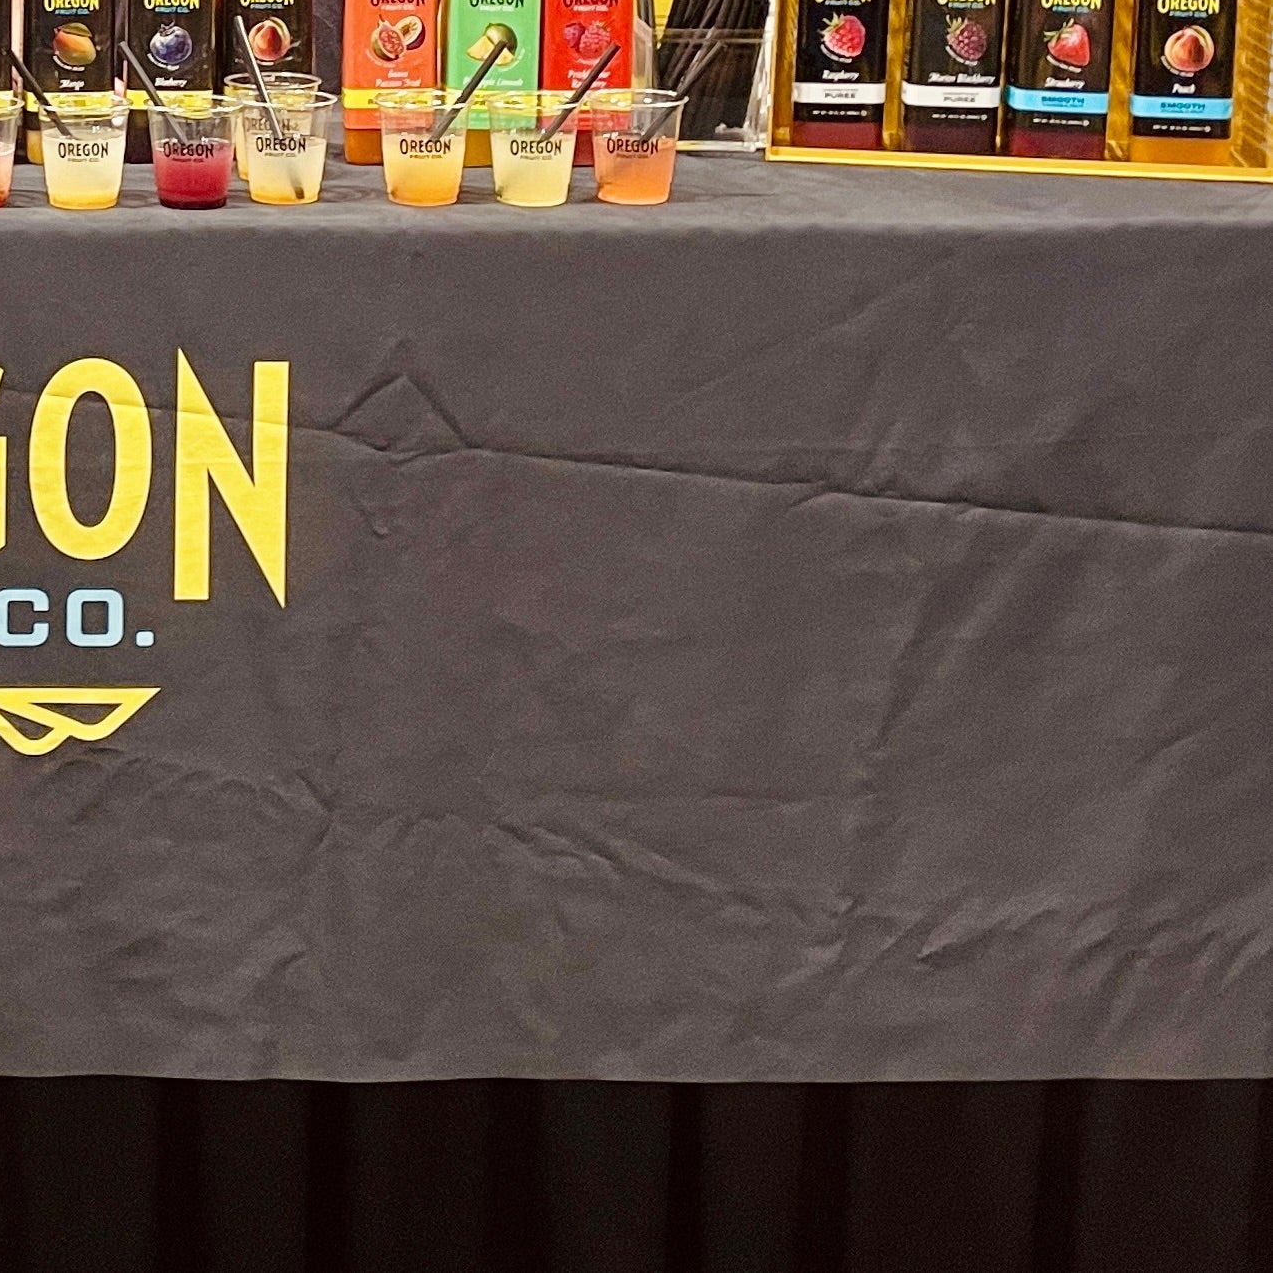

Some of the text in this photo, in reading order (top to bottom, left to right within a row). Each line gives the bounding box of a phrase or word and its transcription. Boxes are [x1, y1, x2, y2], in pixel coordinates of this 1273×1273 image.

[58, 142, 109, 159] OREGON
[163, 141, 214, 158] OREGON
[256, 136, 306, 153] OREGON
[400, 138, 451, 155] OREGON
[510, 139, 562, 156] OREGON
[607, 138, 659, 155] OREGON
